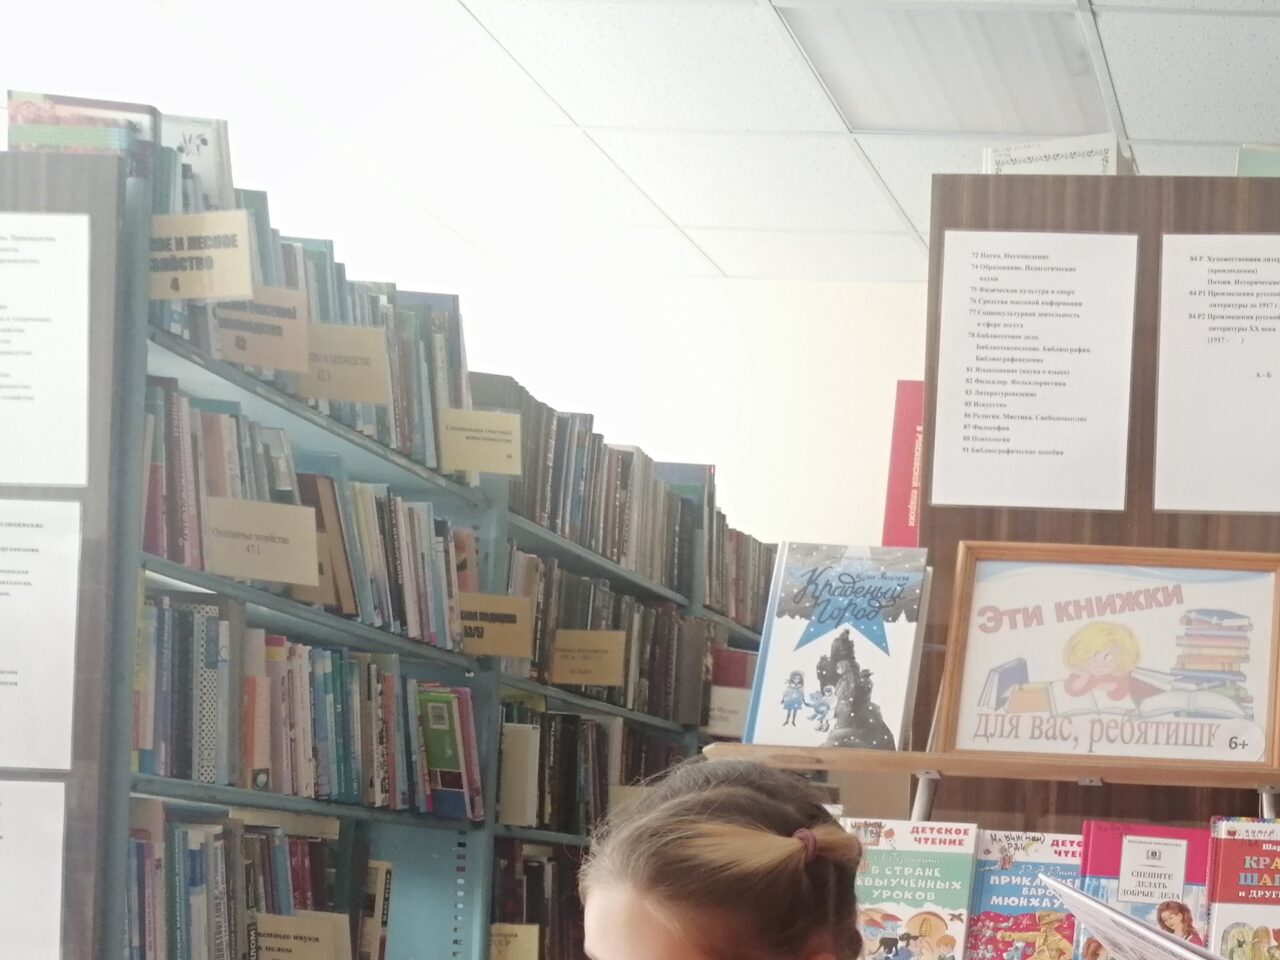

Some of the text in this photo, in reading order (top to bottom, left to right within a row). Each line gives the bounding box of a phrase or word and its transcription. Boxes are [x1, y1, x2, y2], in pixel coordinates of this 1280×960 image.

[976, 583, 1185, 635] Эти книжки
[973, 713, 1222, 754] для вас, ребятишк
[1228, 734, 1249, 751] 6+
[911, 826, 970, 836] ДЕТСКОЕ
[914, 837, 965, 846] ЧТЕНИЕ
[885, 866, 941, 877] СТРАНЕ
[1130, 871, 1174, 881] СПЕШИТЕ
[1134, 880, 1167, 889] ДЕЛАТЬ
[872, 889, 936, 900] УРОКОВ
[1158, 890, 1180, 900] ДЕЛА
